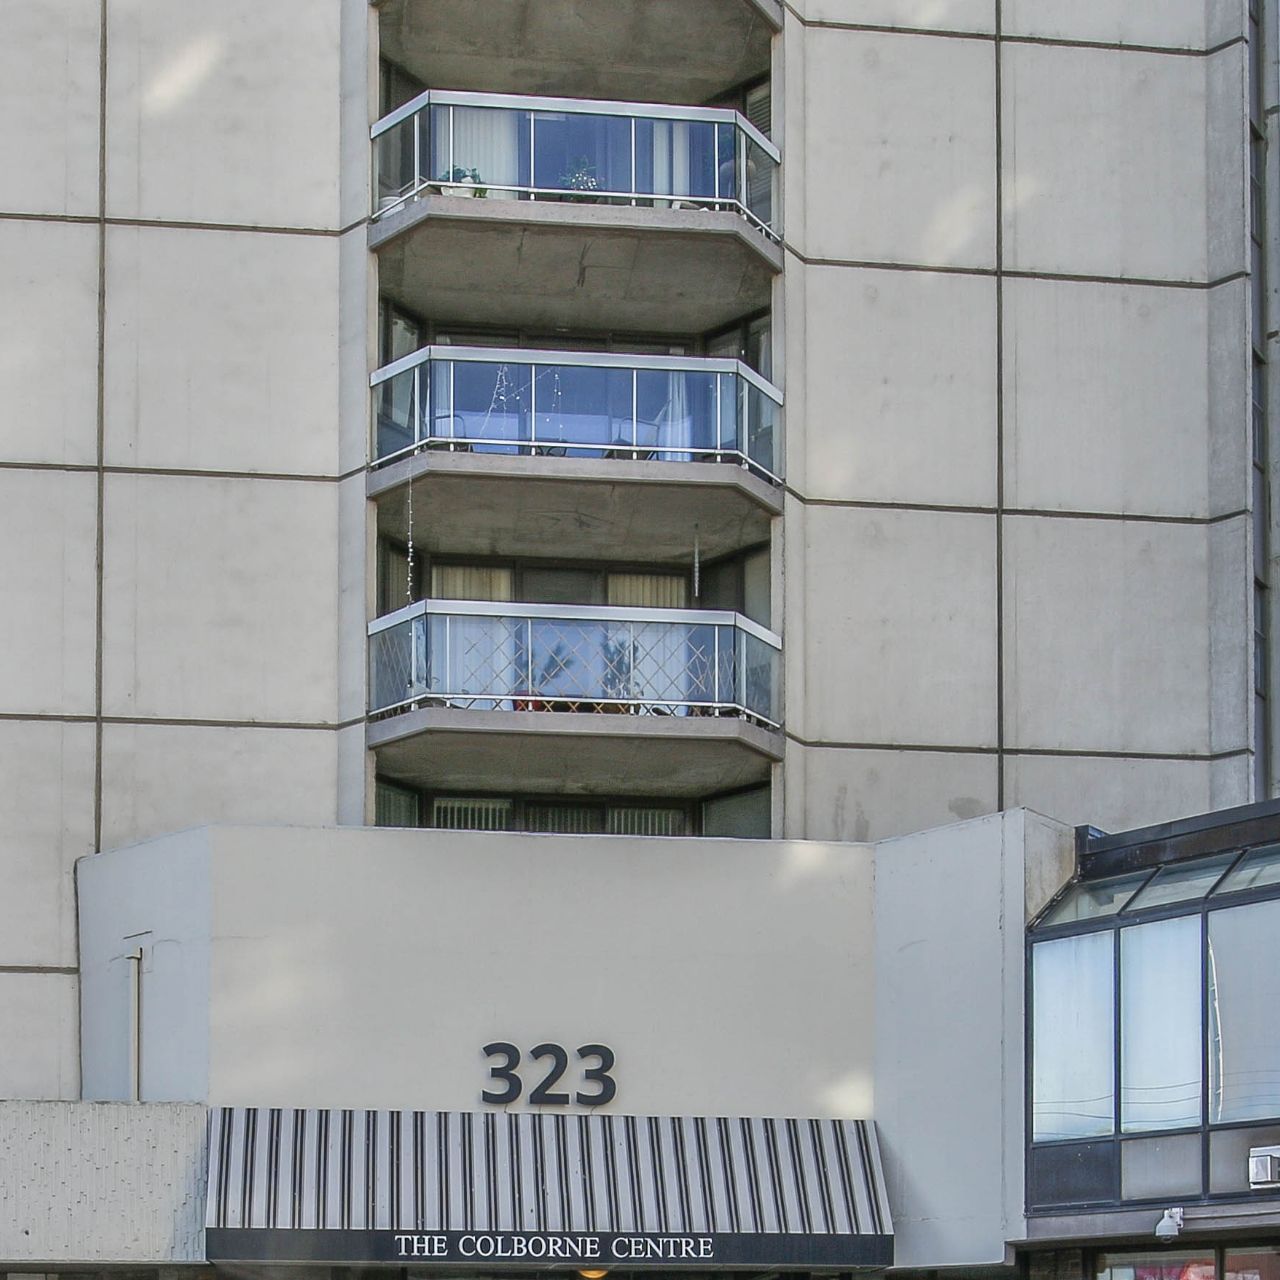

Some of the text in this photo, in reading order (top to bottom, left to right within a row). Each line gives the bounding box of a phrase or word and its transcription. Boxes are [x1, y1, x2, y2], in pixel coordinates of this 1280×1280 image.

[481, 1041, 617, 1106] 323
[394, 1235, 714, 1258] THE COLBORNE CENTRE
